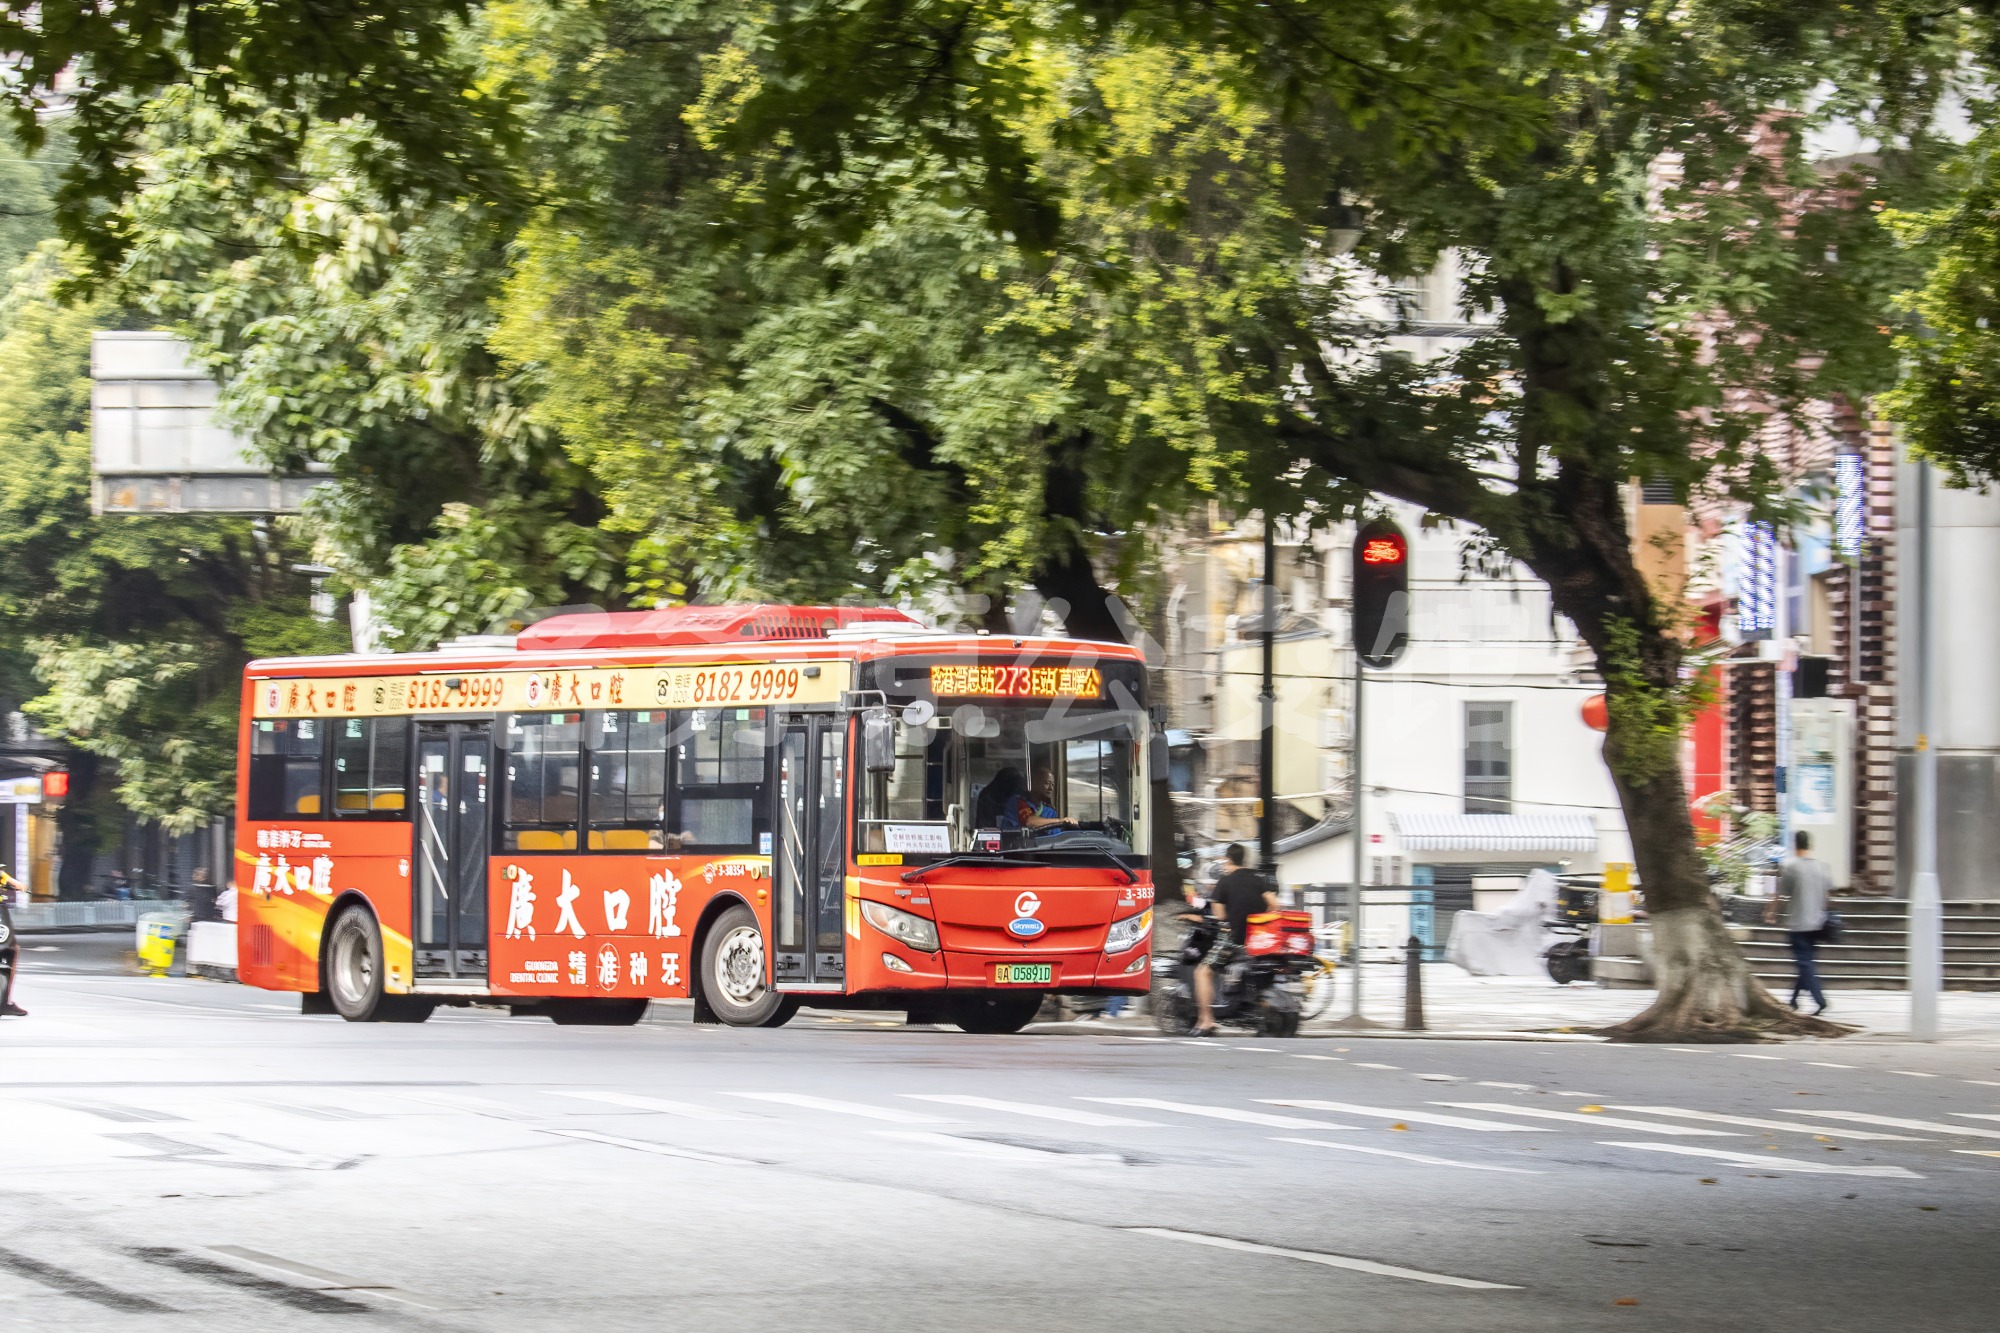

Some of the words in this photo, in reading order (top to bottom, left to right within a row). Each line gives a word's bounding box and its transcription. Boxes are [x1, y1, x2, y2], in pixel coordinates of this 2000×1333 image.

[458, 677, 504, 708] 9999
[693, 671, 743, 703] 8182
[749, 668, 799, 700] 9999
[995, 666, 1031, 695] 273
[718, 865, 744, 876] 3-38354
[510, 973, 536, 983] DENTAL
[568, 950, 682, 986] 精准种牙
